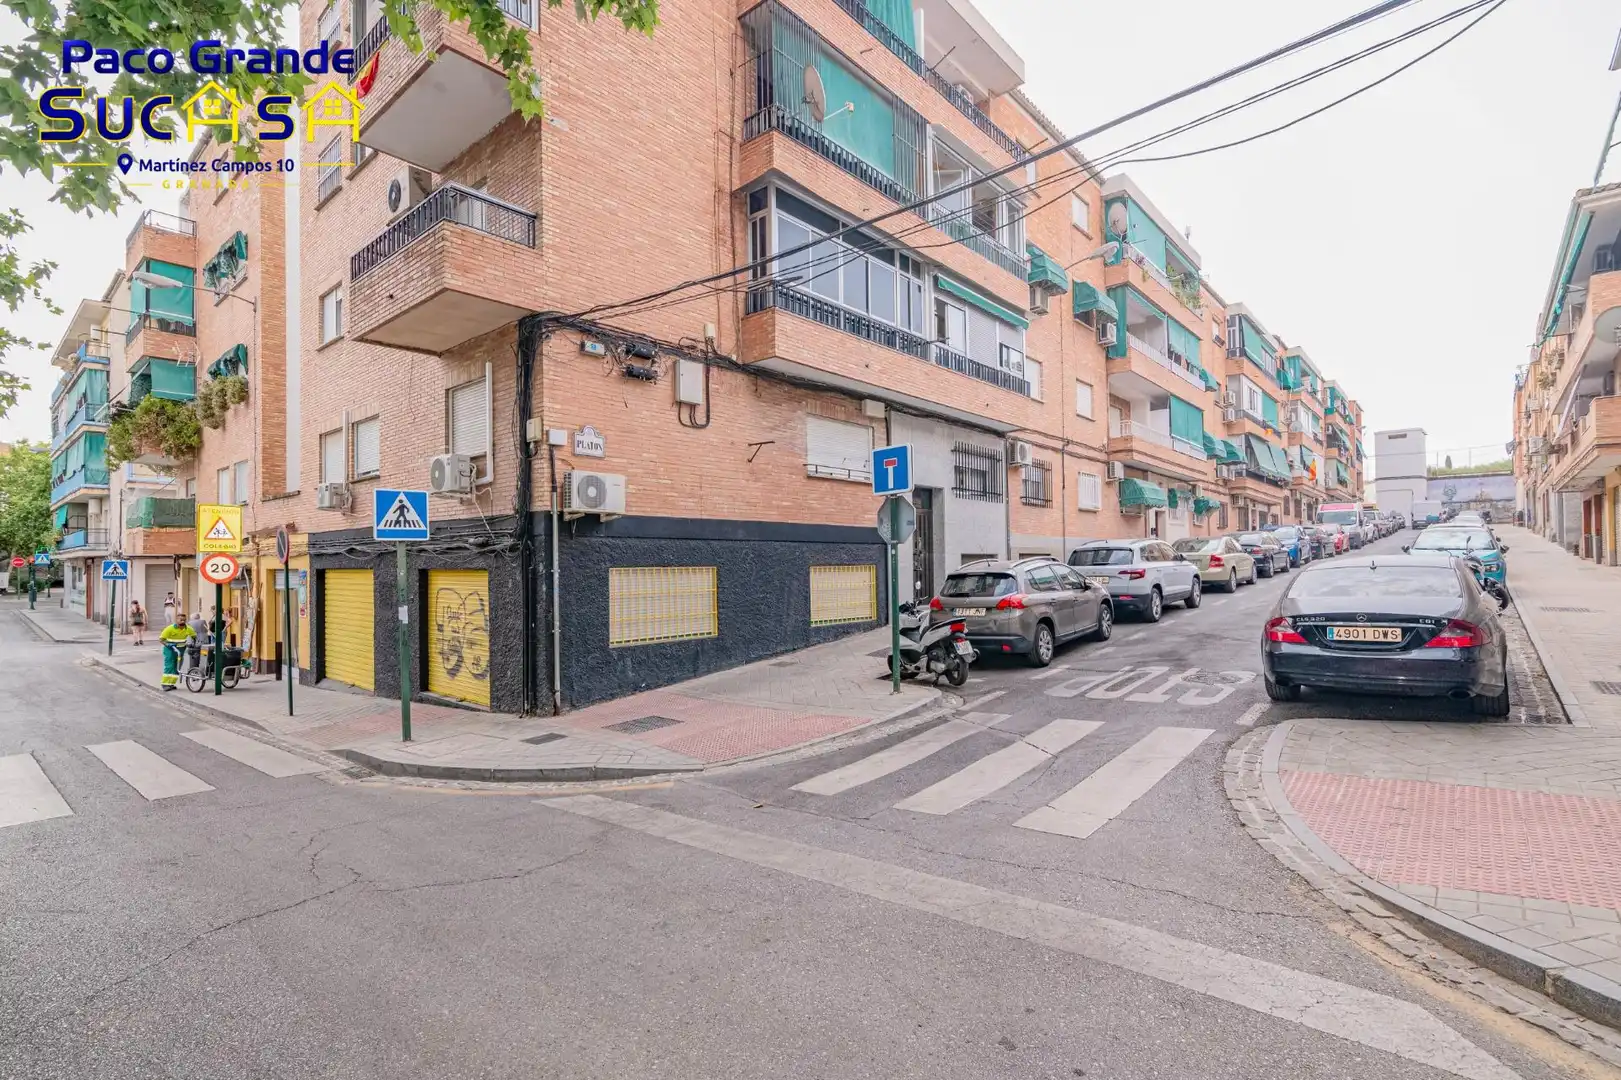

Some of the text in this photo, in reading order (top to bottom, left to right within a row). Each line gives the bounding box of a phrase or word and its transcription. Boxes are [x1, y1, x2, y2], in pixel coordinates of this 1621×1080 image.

[210, 563, 231, 574] 20
[1335, 627, 1399, 640] 4901 DWS
[1044, 666, 1257, 706] STOP
